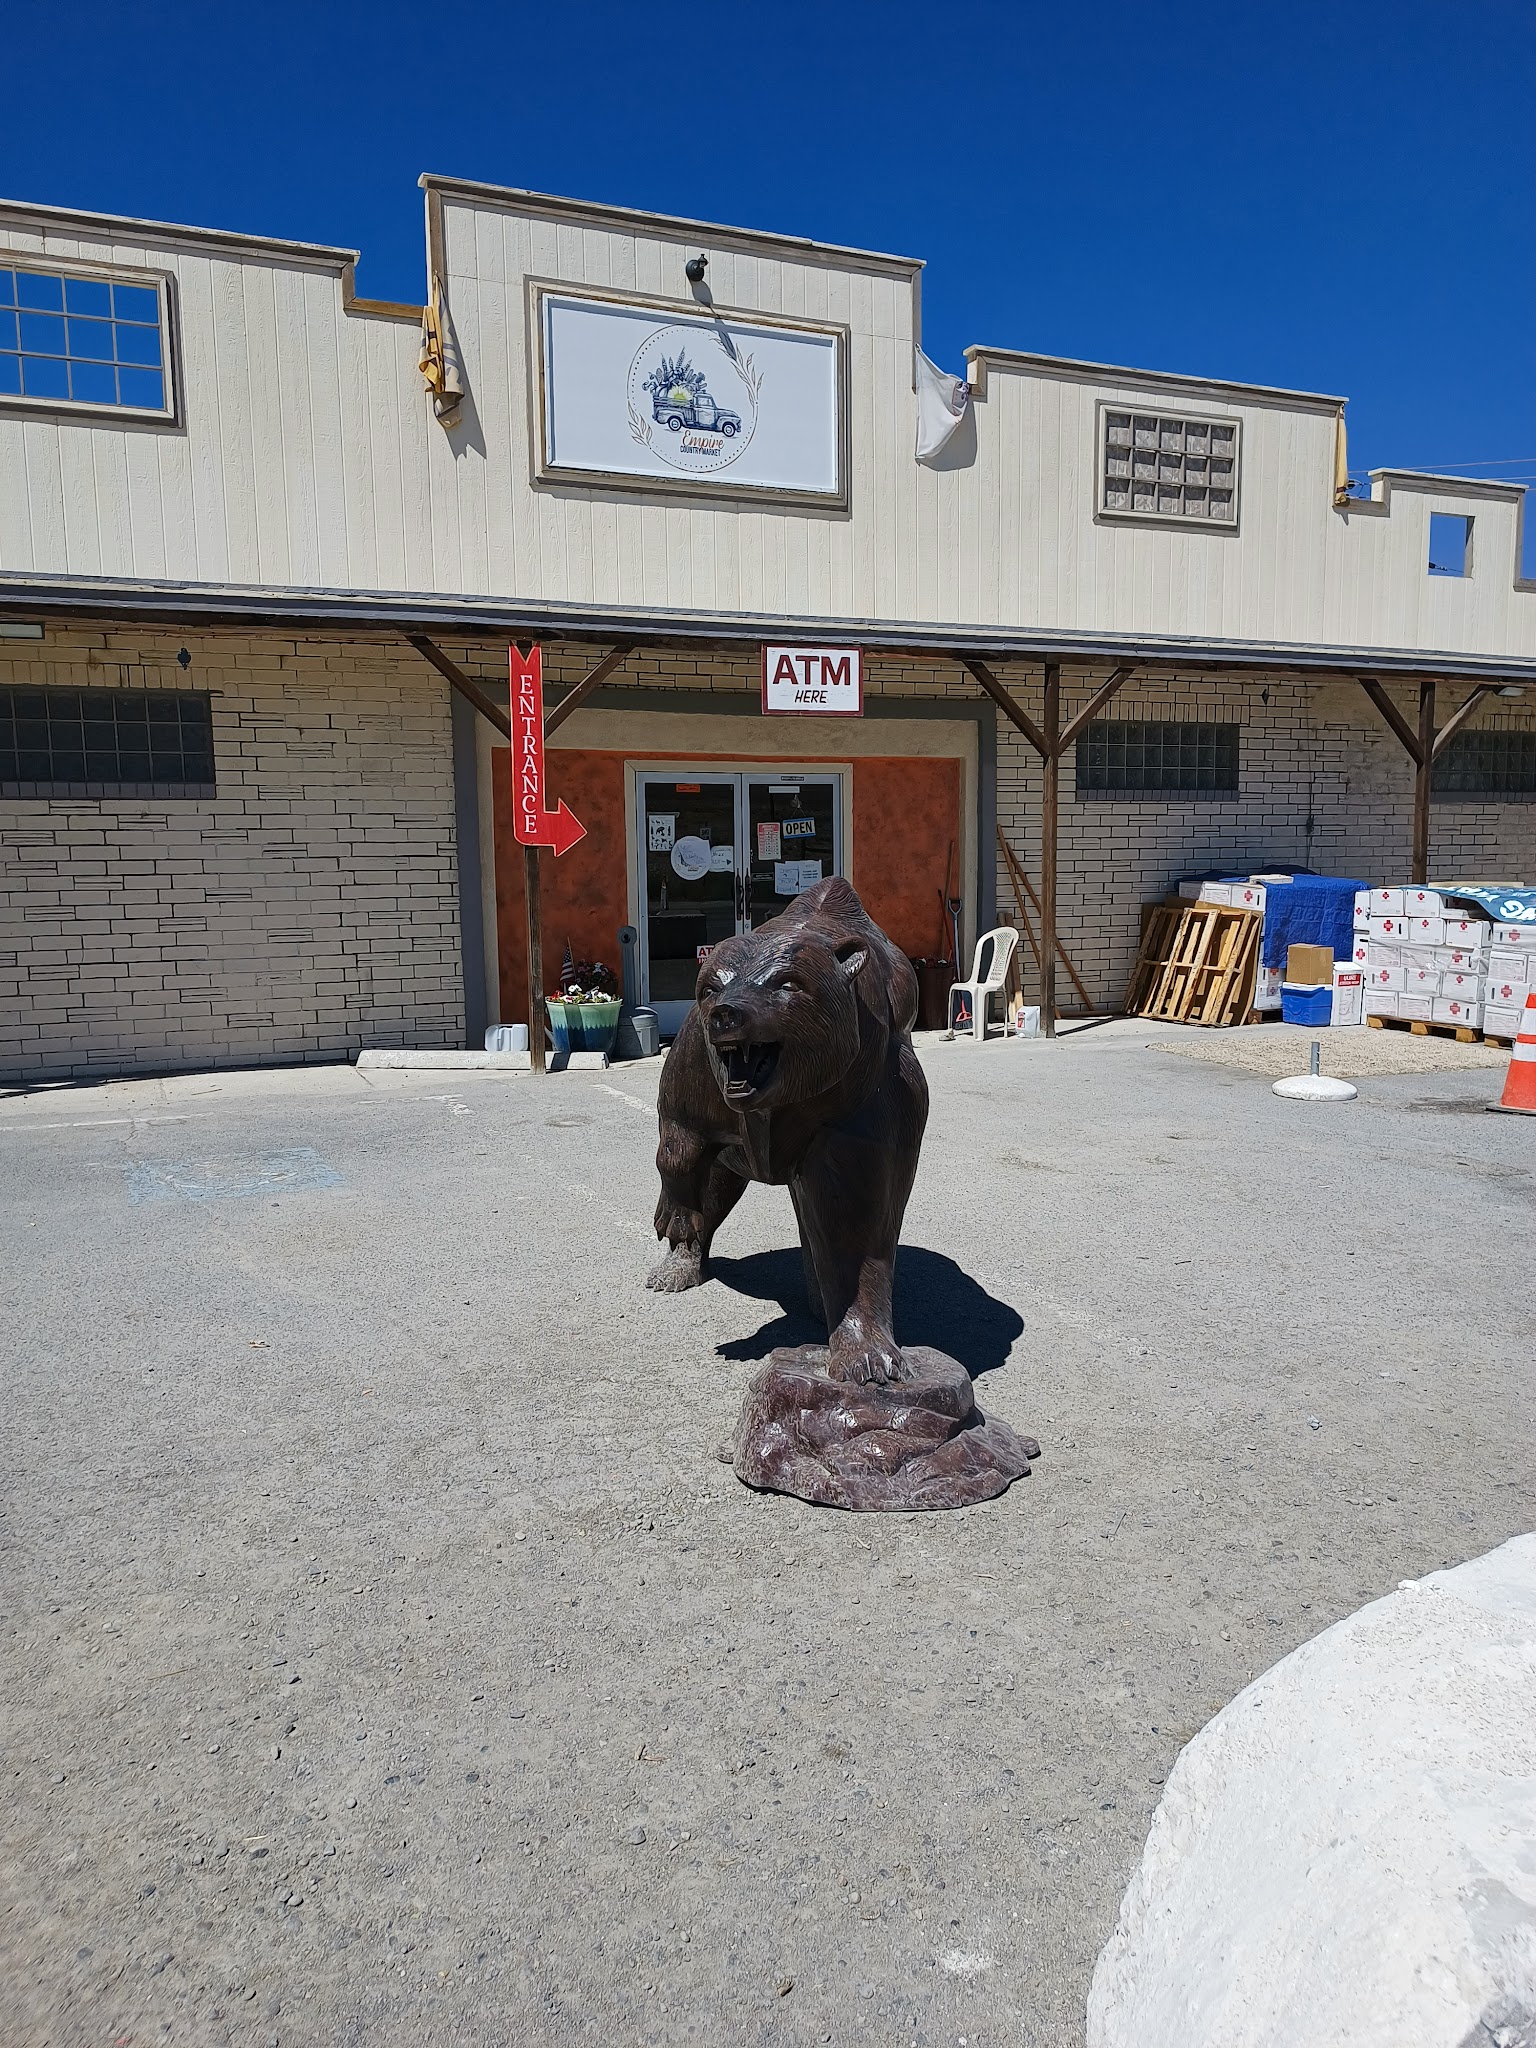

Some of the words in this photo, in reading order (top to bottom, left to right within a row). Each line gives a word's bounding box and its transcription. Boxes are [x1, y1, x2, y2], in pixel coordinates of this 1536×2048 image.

[682, 430, 725, 449] Empire
[680, 445, 701, 456] COUNTRY
[702, 448, 721, 457] MARKET
[773, 655, 851, 685] ATM
[794, 690, 828, 704] HERE
[518, 675, 539, 834] ENTRANCE
[785, 821, 813, 835] OPEN
[698, 946, 713, 957] AT
